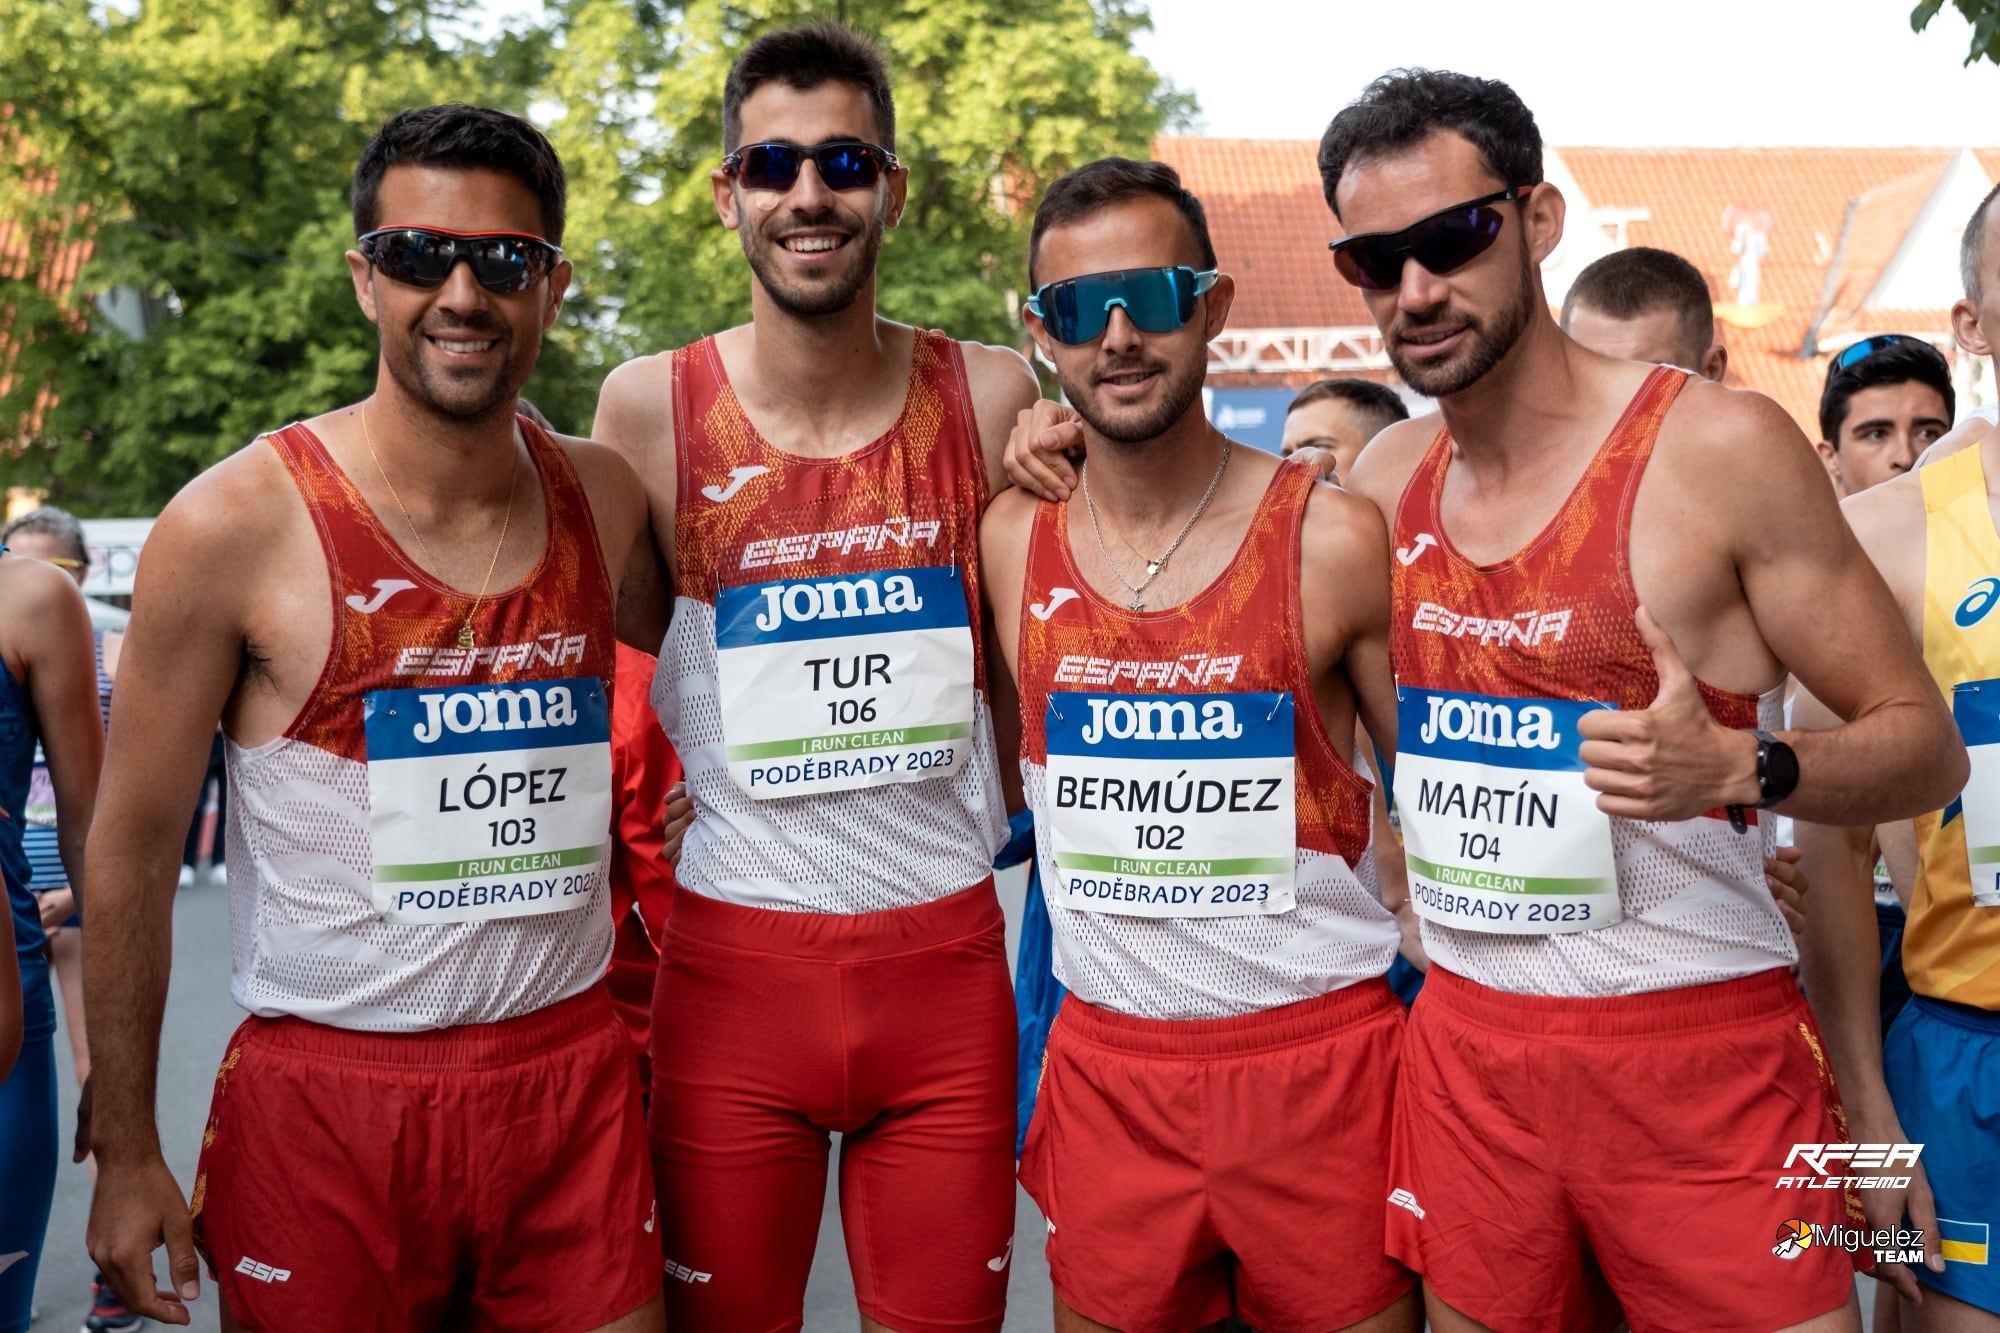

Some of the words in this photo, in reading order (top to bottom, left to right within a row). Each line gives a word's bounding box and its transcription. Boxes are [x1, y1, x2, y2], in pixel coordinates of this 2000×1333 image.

[739, 516, 941, 570] ESPAÑA
[1412, 602, 1573, 648] ESPAÑA
[393, 632, 588, 677] ESPAÑA
[1053, 653, 1244, 688] ESPAÑA
[804, 653, 892, 691] TUR
[827, 697, 877, 726] 106
[812, 737, 847, 752] RUN
[850, 730, 905, 747] CLEAN
[750, 754, 900, 787] PODĚBRADY
[906, 748, 954, 771] 2023
[439, 763, 567, 812] LÓPEZ
[1056, 769, 1282, 813] BERMÚDEZ
[1418, 778, 1558, 829] MARTÍN
[488, 817, 536, 847] 103
[1134, 824, 1185, 850] 102
[1459, 832, 1501, 862] 104
[468, 859, 506, 876] RUN
[510, 853, 561, 871] CLEAN
[1121, 860, 1151, 874] RUN
[1154, 861, 1211, 876] CLEAN
[1442, 867, 1472, 885] RUN
[1475, 872, 1525, 892] CLEAN
[398, 877, 558, 911] PODĚBRADY
[1069, 877, 1205, 904] PODĚBRADY
[1210, 883, 1269, 903] 2023
[1415, 882, 1520, 921] PODĚBRADY
[1527, 903, 1591, 921] 2023
[234, 1255, 292, 1284] ESP
[664, 1259, 713, 1284] ESP
